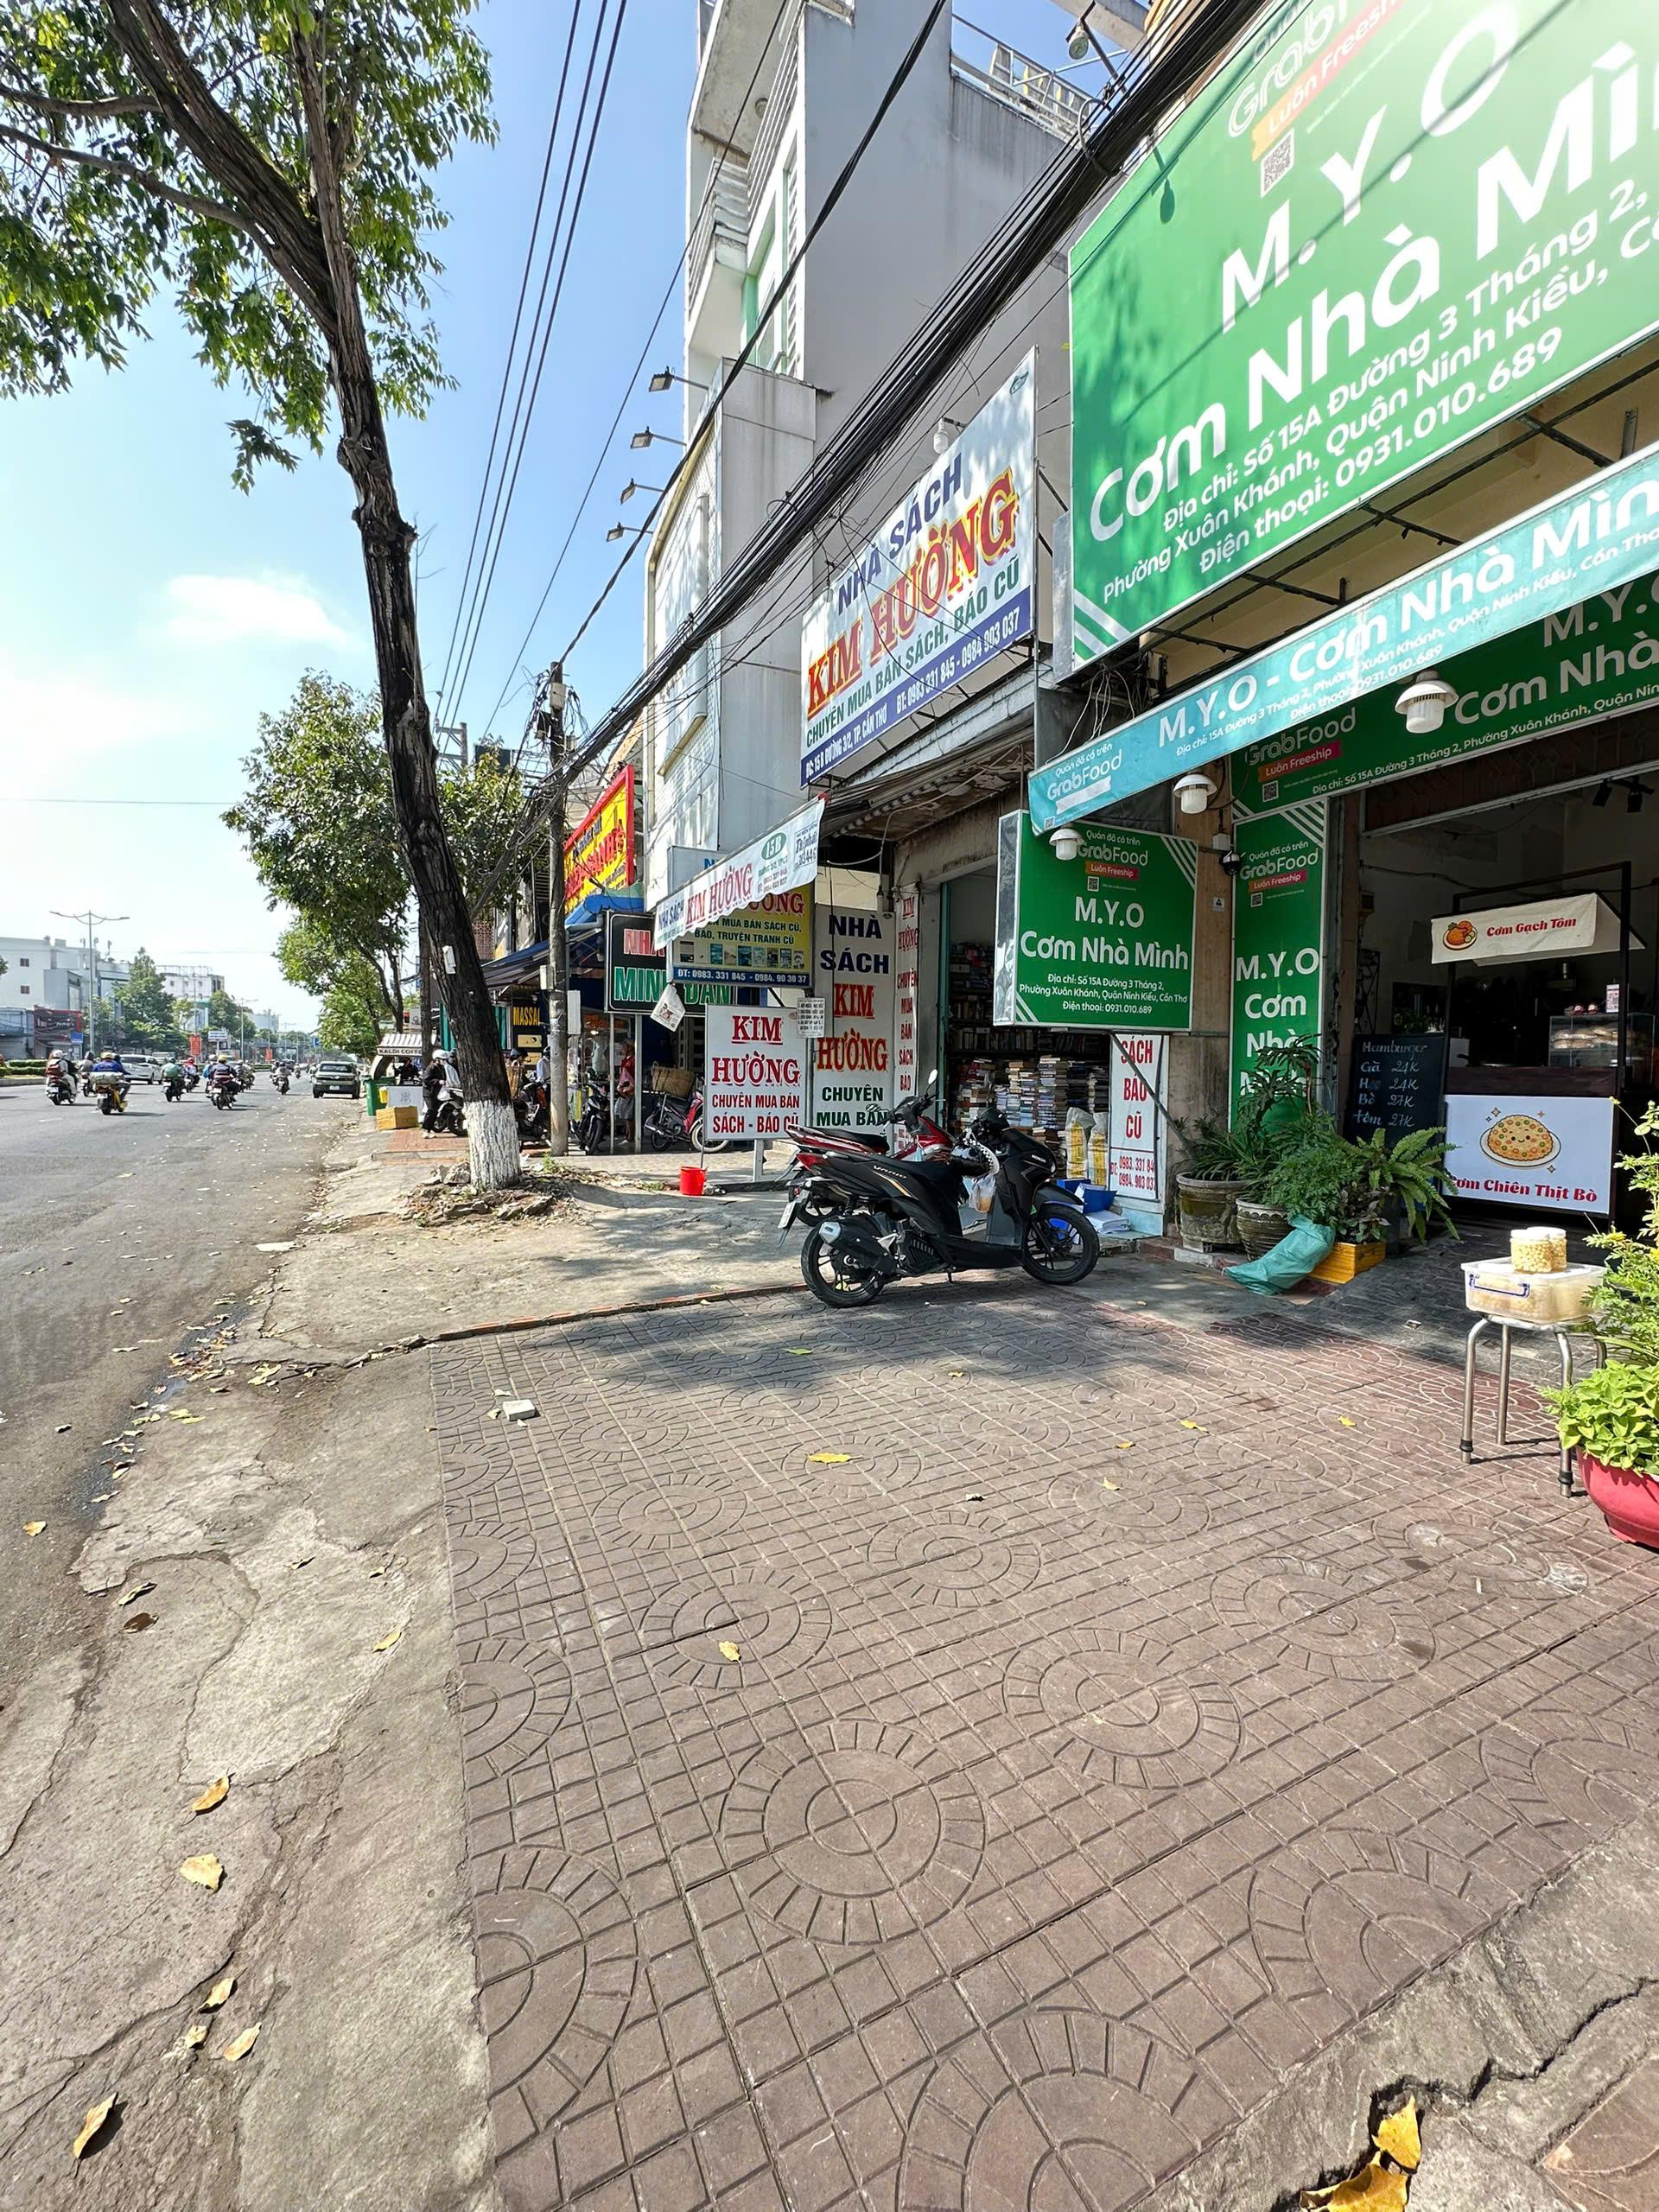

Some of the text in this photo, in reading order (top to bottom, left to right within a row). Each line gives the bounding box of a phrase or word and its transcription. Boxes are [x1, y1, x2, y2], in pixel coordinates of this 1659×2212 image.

[1321, 0, 1398, 79] Frees
[1228, 0, 1348, 137] Grab
[1090, 401, 1225, 542] Cơm
[1249, 223, 1440, 432] Nhà
[1477, 41, 1659, 261] Mì
[1163, 179, 1648, 533] Địa chỉ: Số 15A Đường 3 Tháng 2,
[1199, 326, 1562, 574] Điện thoại: 0931.010.689
[1104, 546, 1171, 604] Phường
[1175, 508, 1229, 558] Xuân
[1234, 449, 1319, 519] Khánh,
[1326, 387, 1408, 457] Quận
[1416, 327, 1496, 398] Ninh
[889, 452, 962, 559] SÁCH
[807, 469, 1020, 719] KIM HƯỜNG
[962, 636, 982, 668] 0984
[1001, 606, 1020, 639] 037
[1159, 674, 1257, 747] M.Y.O
[1290, 613, 1387, 682] Cơm
[1401, 544, 1515, 633] Nhà
[806, 554, 1020, 748] CHUYÊN MUA BÁN SÁCH, BÁO CŨ
[1210, 728, 1224, 741] 15A
[1225, 713, 1257, 734] Đường
[1266, 693, 1300, 715] Tháng
[1362, 649, 1395, 672] Xuân
[1448, 606, 1490, 632] Quận
[1492, 586, 1530, 612] Ninh
[1454, 630, 1659, 725] Cơm Nhà
[1245, 706, 1357, 766] GrabFood
[1313, 780, 1328, 795] Địa
[1329, 775, 1344, 790] chỉ:
[1344, 772, 1357, 785] Số
[1358, 769, 1374, 783] 15A
[1375, 759, 1408, 777] Đường
[1408, 756, 1415, 766] 3
[1417, 744, 1451, 764] Tháng
[1464, 728, 1508, 750] Phường
[1510, 719, 1542, 735] Xuân
[1545, 703, 1591, 726] Khánh,
[1594, 692, 1633, 710] Quận
[1047, 748, 1122, 801] GrabFood
[1266, 747, 1332, 778] Luôn Freeship
[766, 835, 782, 859] 15B
[1086, 830, 1141, 847] Quán trên
[1249, 840, 1309, 862] Quán trên
[1077, 841, 1148, 867] GrabFood
[1240, 847, 1319, 880] GrabFood
[1090, 864, 1134, 878] Luôn Freeship
[1271, 873, 1301, 887] Freeship
[686, 889, 707, 926] KIM
[709, 862, 753, 916] HƯỜNG
[903, 897, 915, 918] KIM
[1075, 895, 1145, 928] M.Y.O
[722, 918, 741, 928] MUA
[743, 917, 762, 930] BÁN
[764, 919, 785, 931] SÁCH
[829, 913, 883, 939] NHÀ
[1486, 918, 1577, 938] Cơm Gạch Tôm
[717, 931, 781, 944] TRUYỆN TRANH
[898, 925, 918, 950] HƯỜNG
[1020, 930, 1189, 969] Cơm Nhà Mình
[820, 947, 889, 975] SÁCH
[1236, 947, 1319, 982] M.Y.O
[677, 969, 807, 983] ĐT: 0983. 331 845 0984. 37
[1047, 973, 1157, 990] Địa chỉ: Số 15A Đường 3 Tháng
[833, 983, 874, 1018] KIM
[900, 996, 913, 1014] MUA
[1020, 984, 1051, 997] Phường
[1073, 988, 1101, 1000] Khánh,
[1102, 989, 1123, 1001] Quận
[1123, 991, 1140, 1001] Ninh
[1174, 994, 1188, 1003] Thơ
[1244, 993, 1306, 1019] Cơm
[1063, 1001, 1153, 1014] Điện thoại: 0931.010.689
[732, 1015, 784, 1044] KIM
[900, 1020, 912, 1040] BÁN
[817, 1027, 889, 1071] HƯỜNG
[899, 1046, 913, 1065] SÁCH
[1121, 1037, 1154, 1065] SÁCH
[1363, 1039, 1427, 1061] Hamburger
[711, 1051, 801, 1086] HƯỜNG
[1360, 1061, 1382, 1073] Gà
[822, 1085, 884, 1102] CHUYÊN
[899, 1071, 912, 1091] BÁO
[1123, 1073, 1147, 1102] BÁO
[1389, 1077, 1419, 1091] 24K
[712, 1092, 800, 1109] CHUYÊN MUA BÁN
[1358, 1092, 1414, 1107] Bò 27K
[713, 1112, 780, 1133] SÁCH BÁO
[817, 1111, 851, 1127] MUA
[1126, 1111, 1142, 1139] CŨ
[1388, 1113, 1415, 1127] 27K
[1484, 1179, 1530, 1196] Chiên
[1535, 1184, 1570, 1202] Thịt
[1573, 1187, 1598, 1203] Bò
